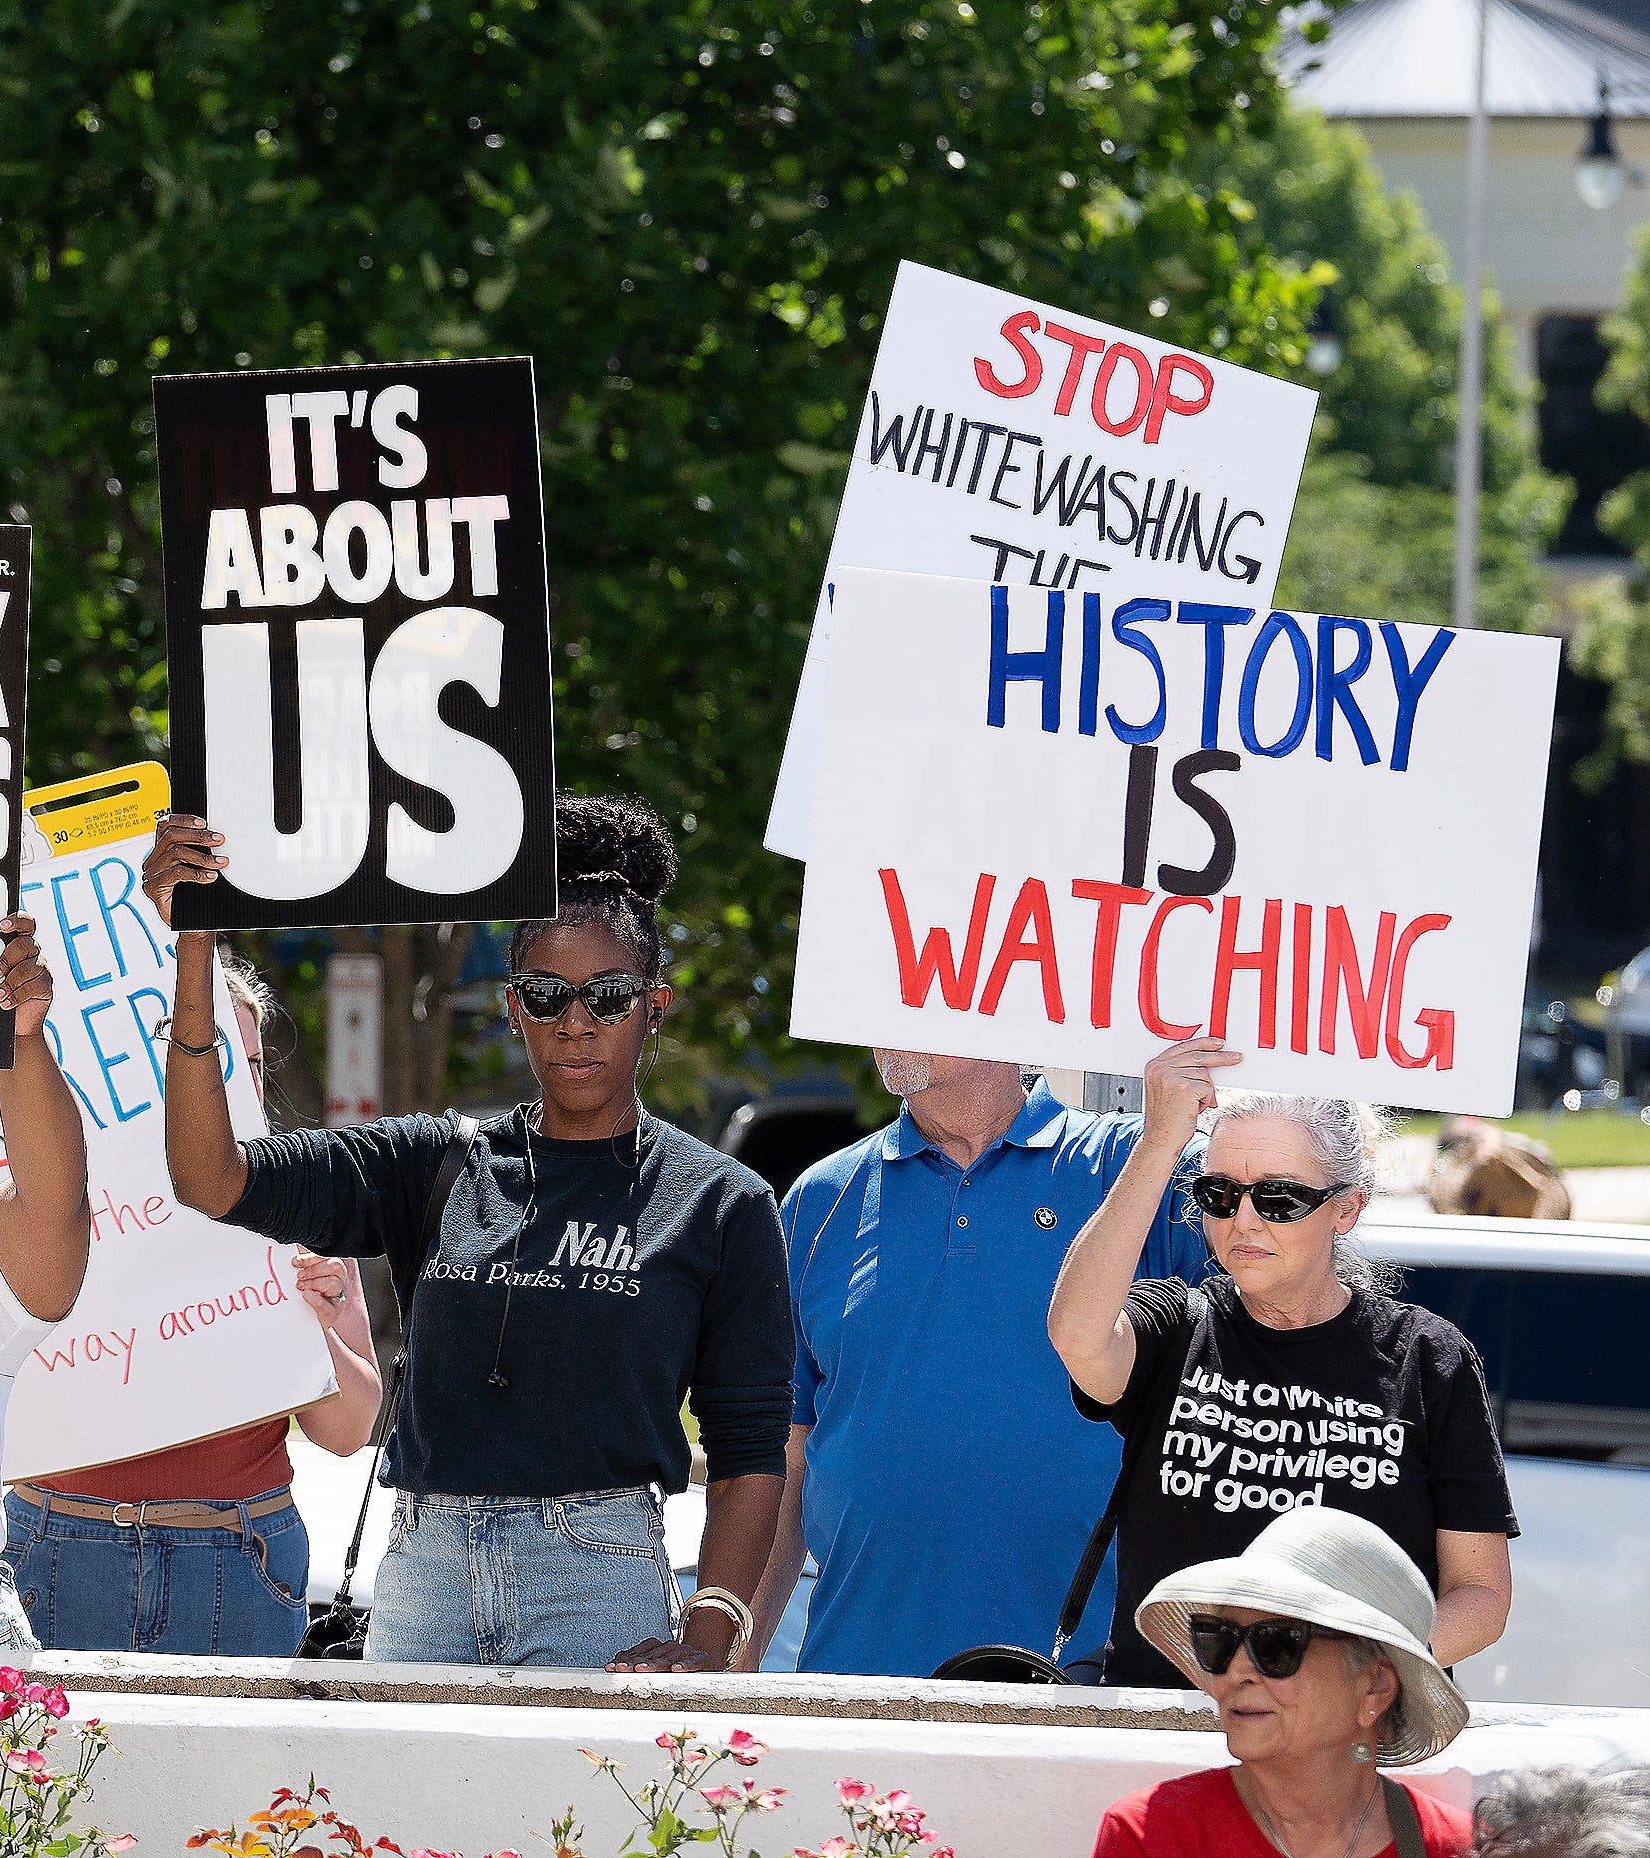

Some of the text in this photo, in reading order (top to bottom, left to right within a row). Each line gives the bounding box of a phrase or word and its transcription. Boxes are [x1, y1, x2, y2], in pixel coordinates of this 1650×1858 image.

[973, 309, 1213, 445] STOP
[266, 384, 428, 494] IT'S
[871, 390, 1266, 585] WHITEWASHING
[201, 495, 510, 609] ABOUT
[986, 584, 1456, 772] HISTORY
[201, 606, 524, 900] US
[53, 830, 69, 844] 30
[1122, 744, 1241, 898] IS
[878, 867, 1455, 1073] WATCHING
[90, 1189, 173, 1241] the
[549, 1221, 641, 1272] Nah.
[33, 1245, 287, 1385] way around
[423, 1259, 641, 1297] Rosa Parks, 1955
[1169, 1395, 1405, 1457] person using
[1181, 1366, 1384, 1418] Just a white
[1160, 1461, 1325, 1513] for good
[1162, 1430, 1400, 1490] my privilege
